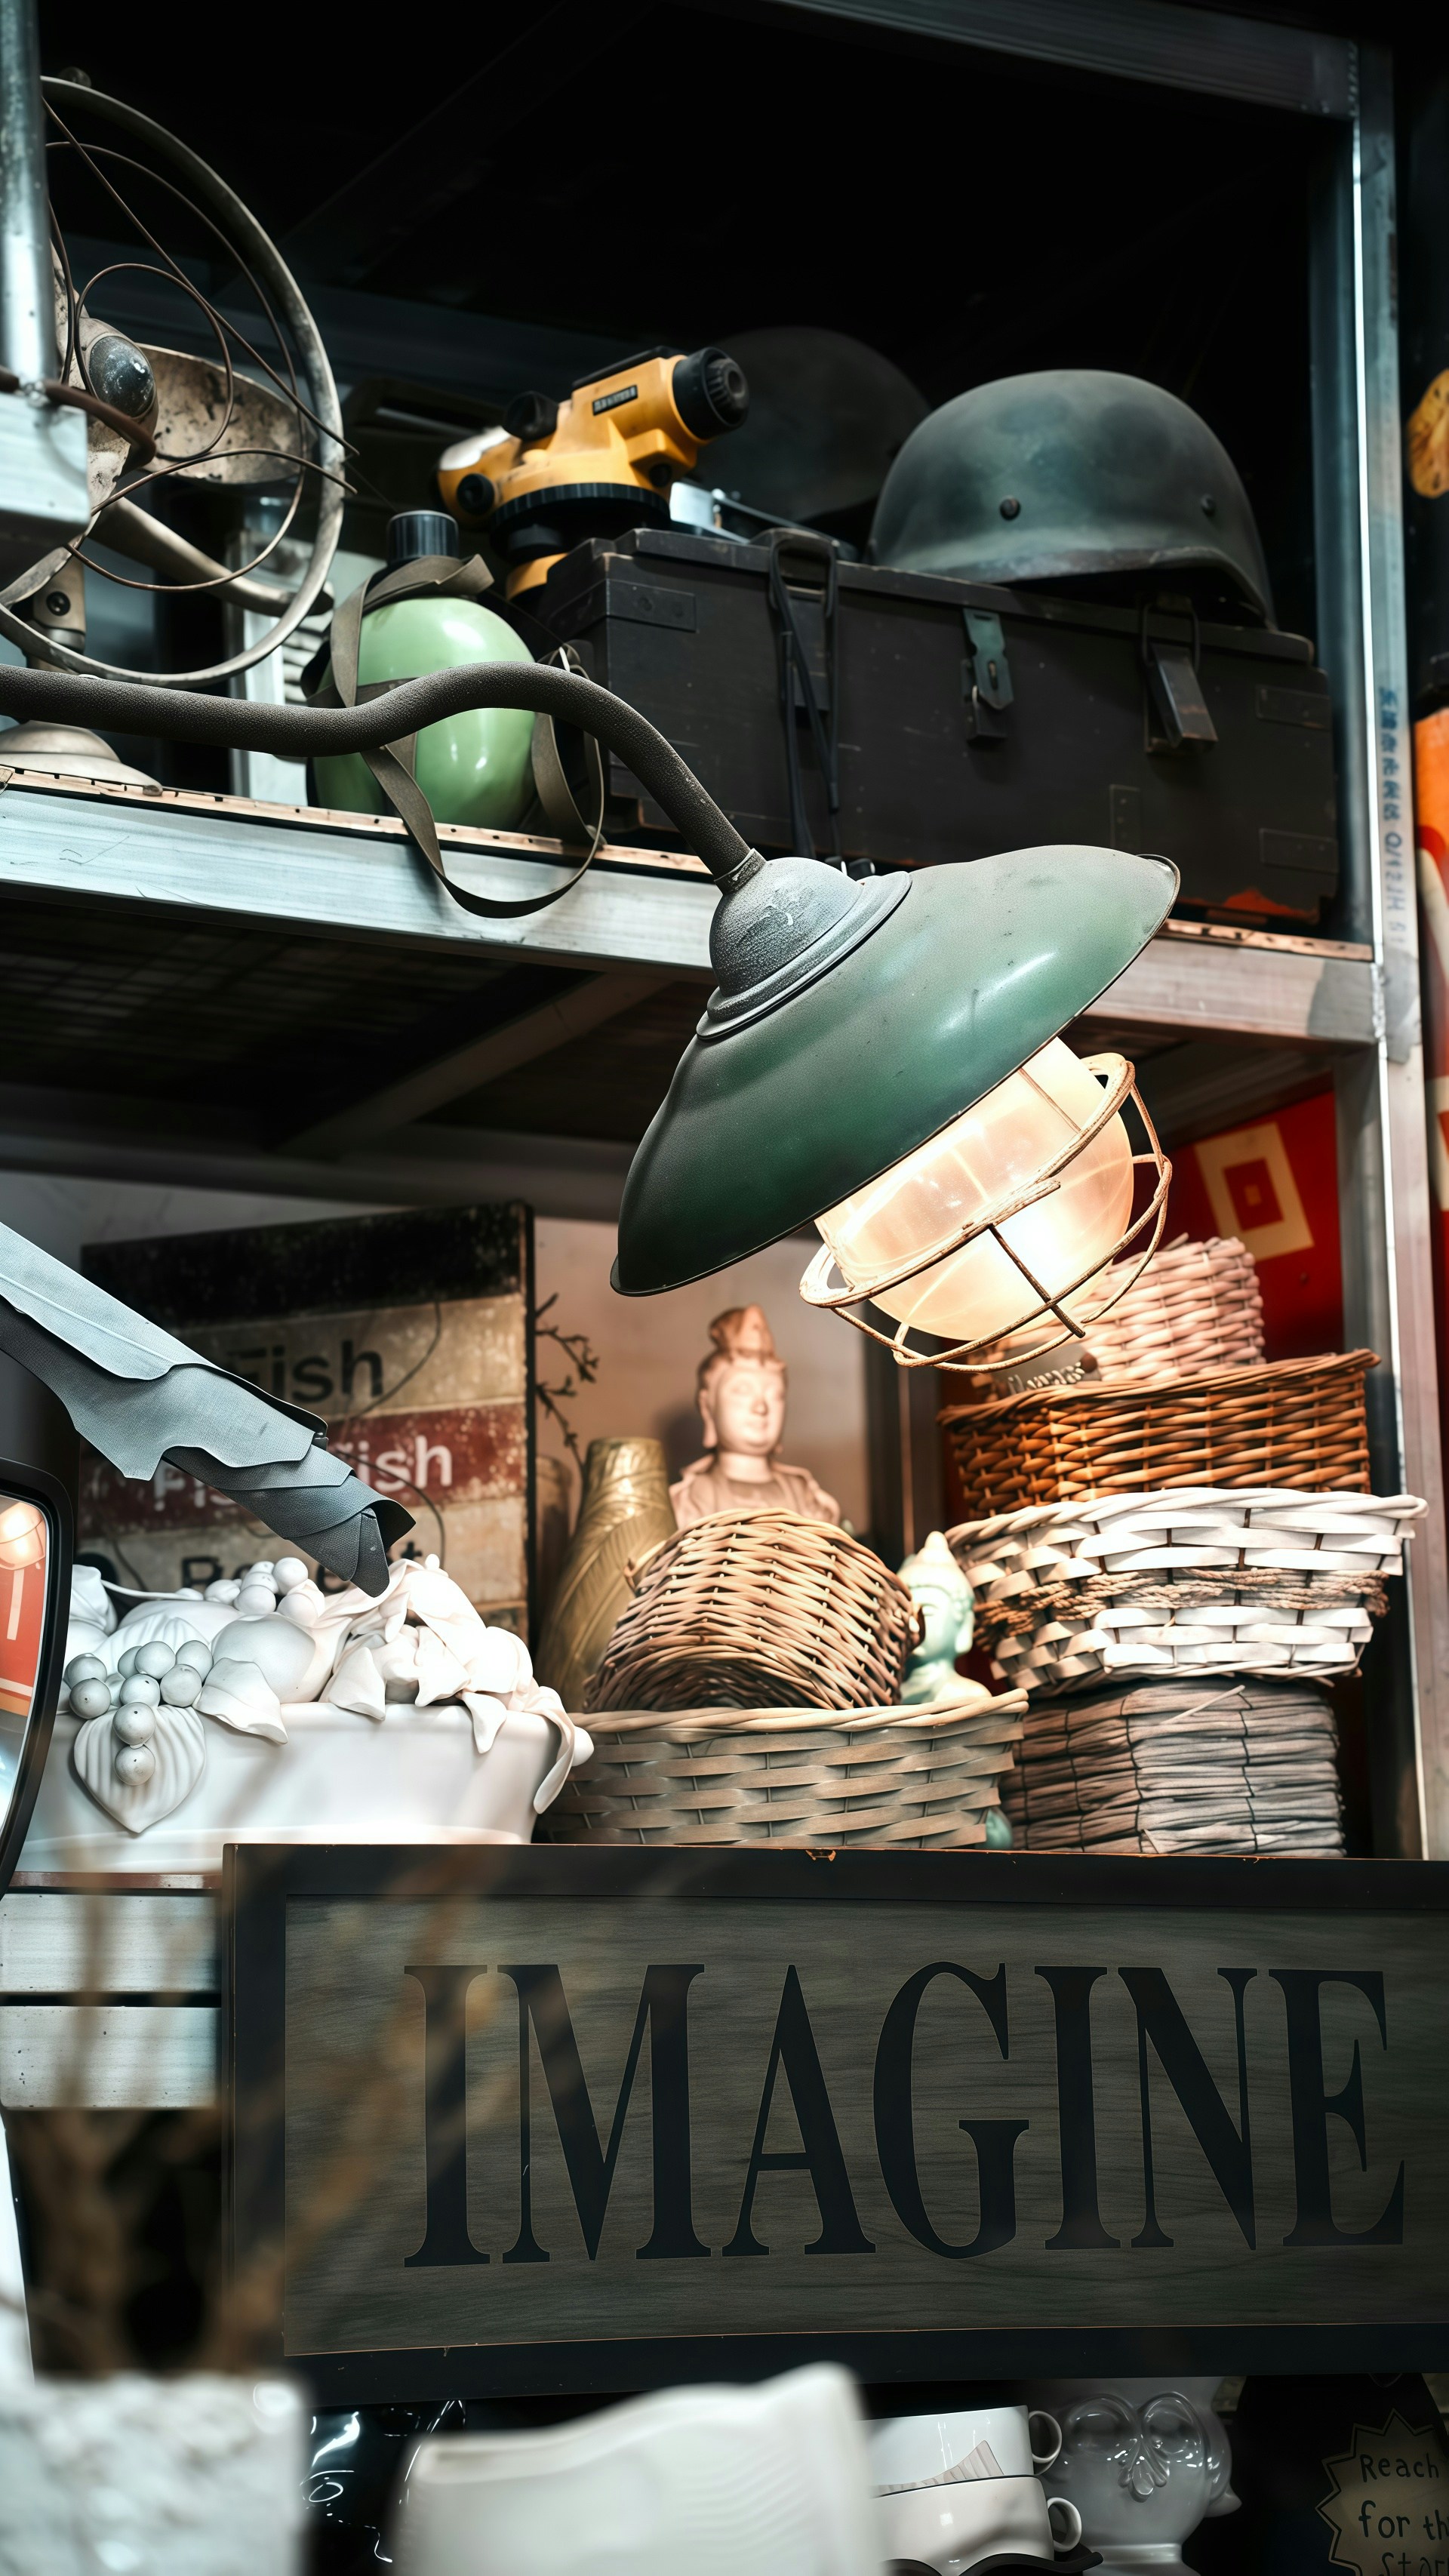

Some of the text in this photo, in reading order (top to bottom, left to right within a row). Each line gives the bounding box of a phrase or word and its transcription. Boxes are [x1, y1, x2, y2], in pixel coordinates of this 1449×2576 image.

[331, 1435, 453, 1493] ish
[403, 1960, 1404, 2268] IMAGINE
[1360, 2452, 1439, 2482] Reach
[1358, 2501, 1449, 2541] for th
[1378, 2553, 1449, 2576] Star
